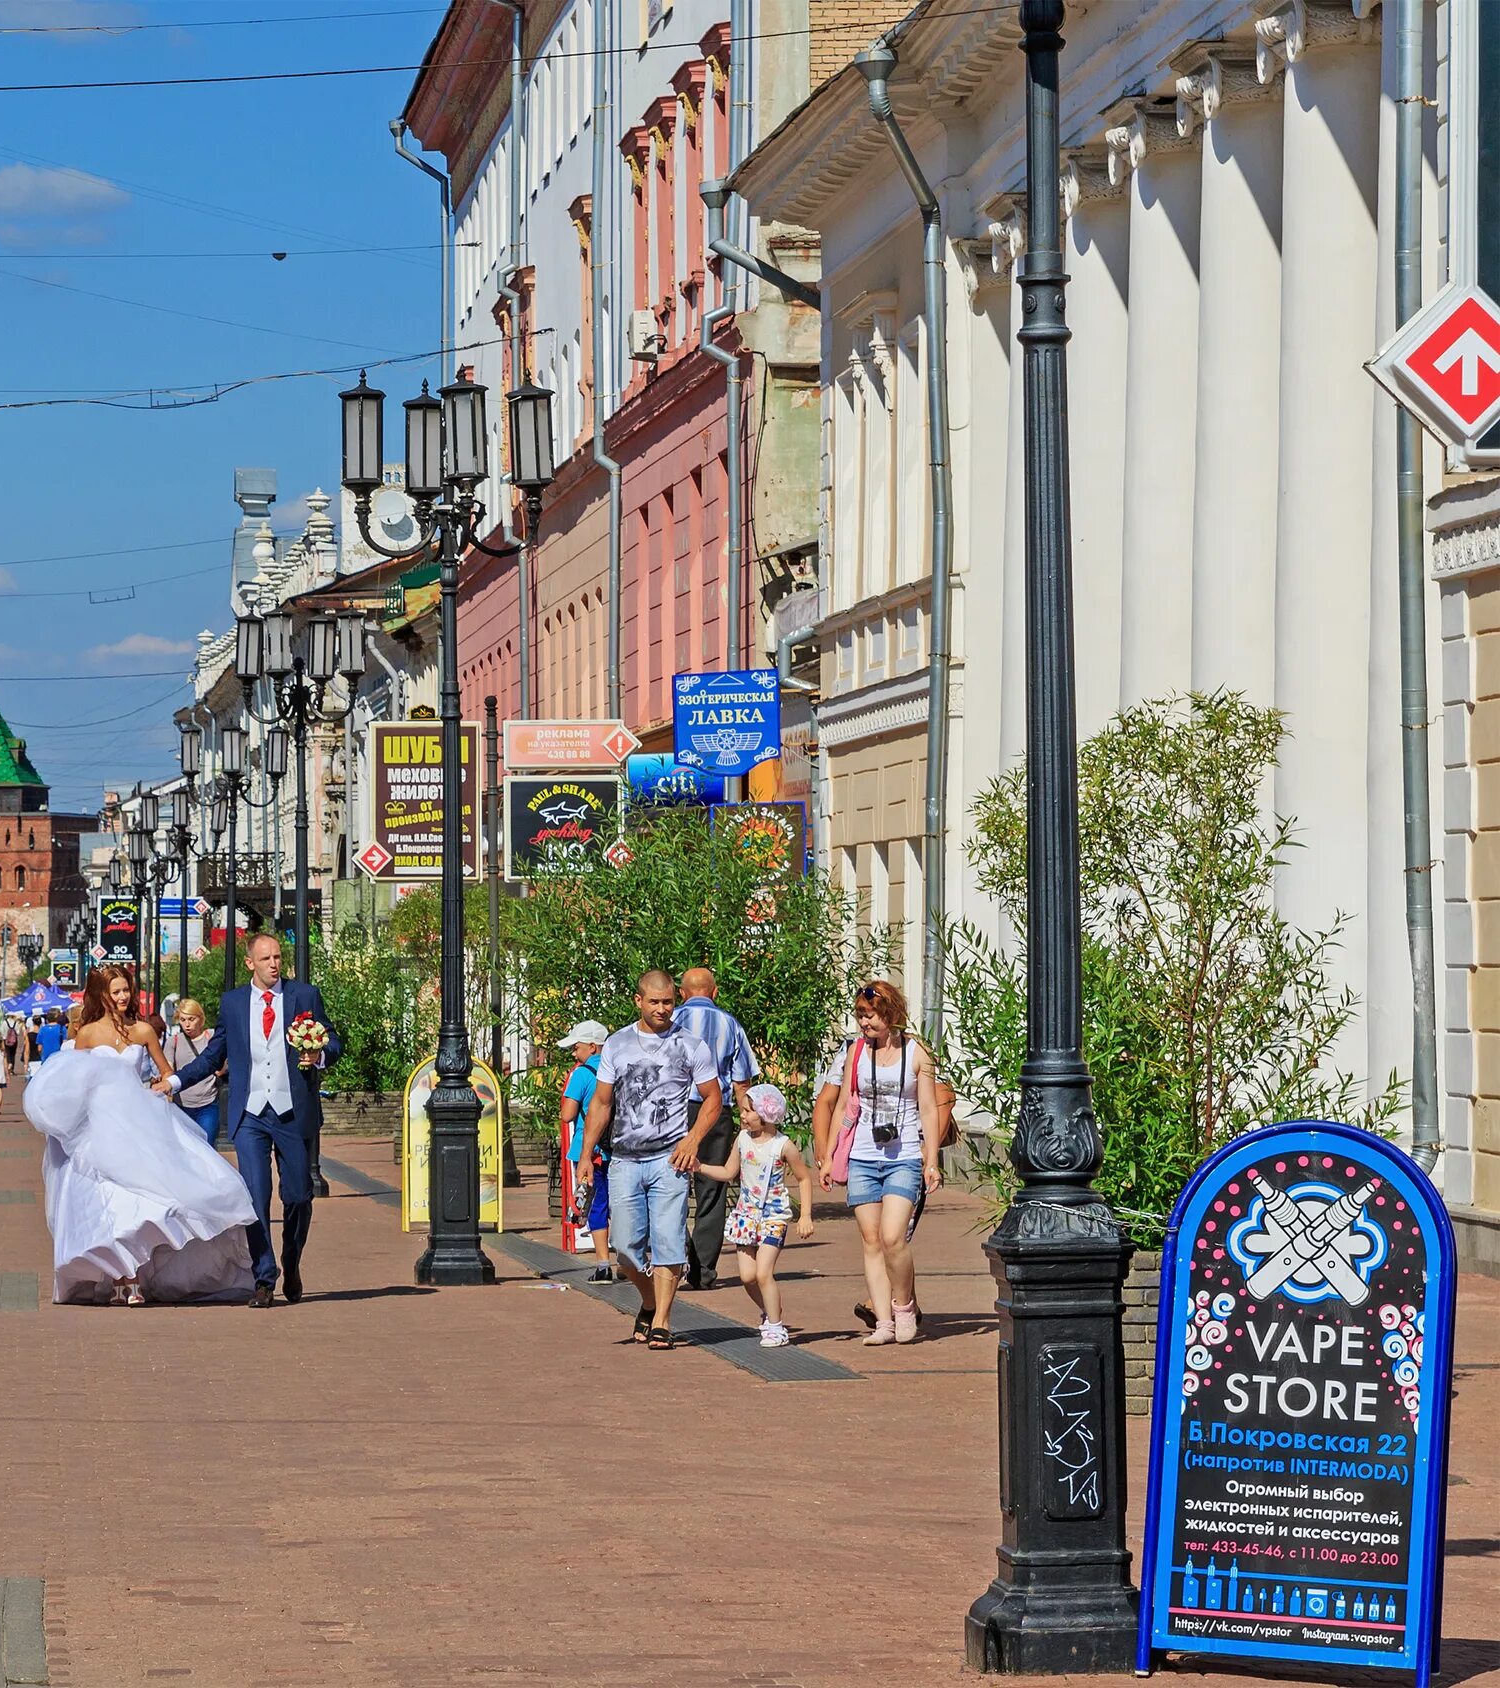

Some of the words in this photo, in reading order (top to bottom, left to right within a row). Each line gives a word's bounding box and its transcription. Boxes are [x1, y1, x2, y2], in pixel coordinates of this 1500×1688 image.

[678, 690, 775, 706] ЭЗОТЕРИЧЕСКАЯ
[687, 708, 766, 726] ЛАВКА
[536, 729, 590, 741] реклама
[394, 855, 419, 867] ВХОД
[113, 945, 128, 954] 90
[1245, 1320, 1365, 1366] VAPE
[1223, 1372, 1379, 1423] STORE
[1376, 1433, 1408, 1457] 22
[1184, 1449, 1285, 1474] (напротив
[1290, 1457, 1409, 1486] INTERMODA)
[1225, 1479, 1309, 1499] Огромный
[1313, 1486, 1364, 1505] выбор
[1184, 1499, 1289, 1518] электронных
[1293, 1508, 1403, 1527] испарителей,
[1185, 1518, 1275, 1536] жидкостей
[1278, 1526, 1288, 1537] и
[1291, 1527, 1400, 1546] аксессуаров
[1184, 1541, 1208, 1552] тел:
[1211, 1540, 1285, 1560] 433-45-46,
[1289, 1549, 1297, 1559] с
[1300, 1547, 1338, 1562] 11.00
[1340, 1553, 1357, 1565] до
[1360, 1551, 1399, 1566] 23.00
[1174, 1616, 1293, 1638] https://vk.com/vpstor
